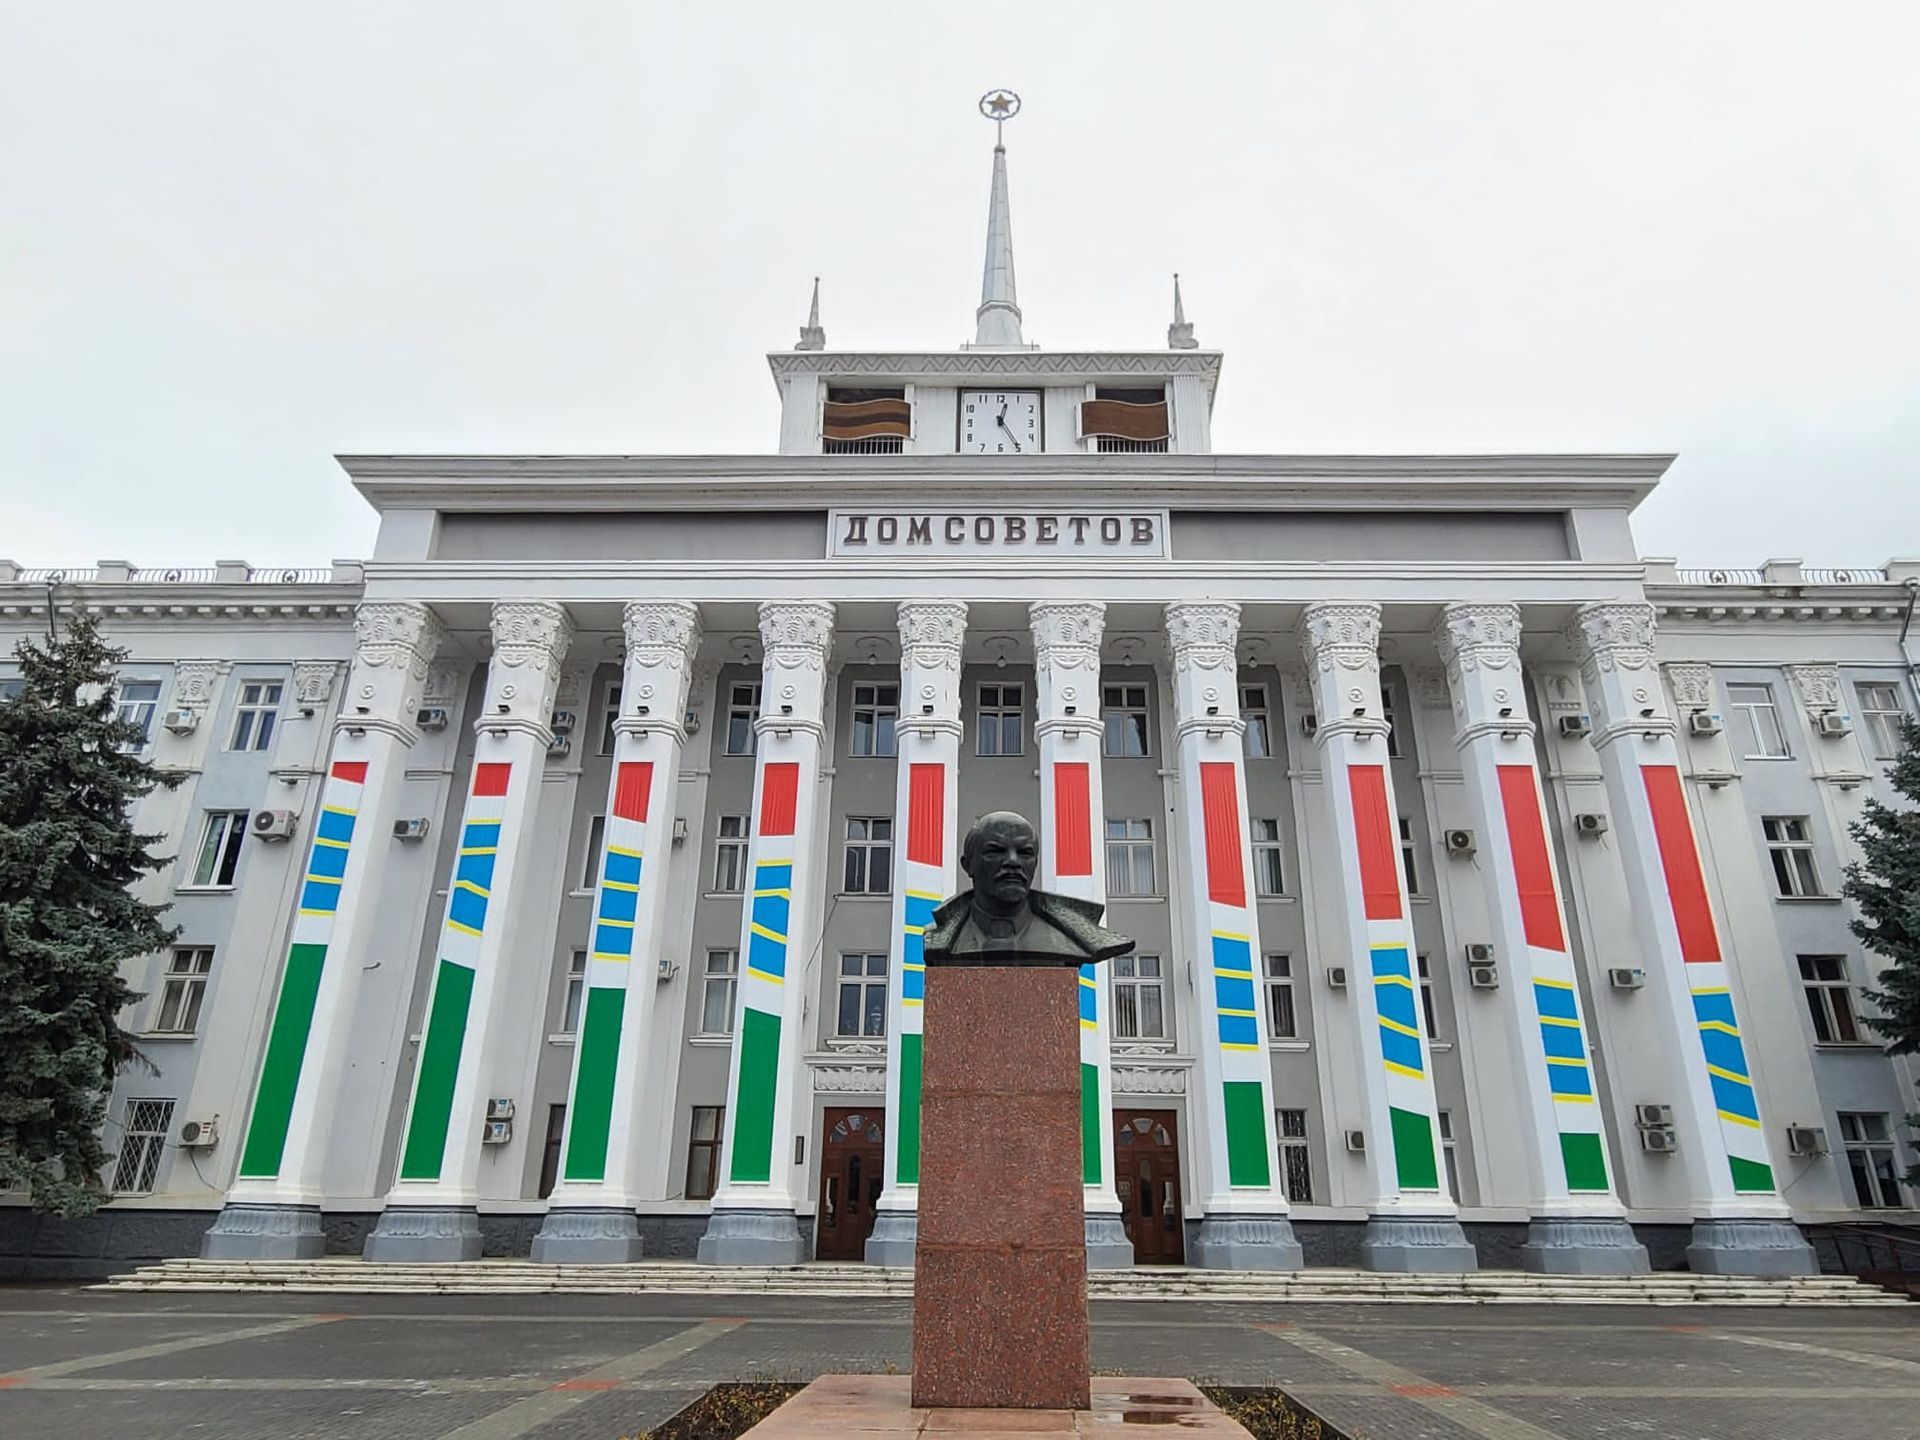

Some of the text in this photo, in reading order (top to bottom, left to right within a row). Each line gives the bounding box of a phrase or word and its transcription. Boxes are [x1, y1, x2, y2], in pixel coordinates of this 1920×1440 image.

[979, 395, 988, 404] 11
[997, 395, 1006, 404] 12
[966, 405, 975, 413] 10
